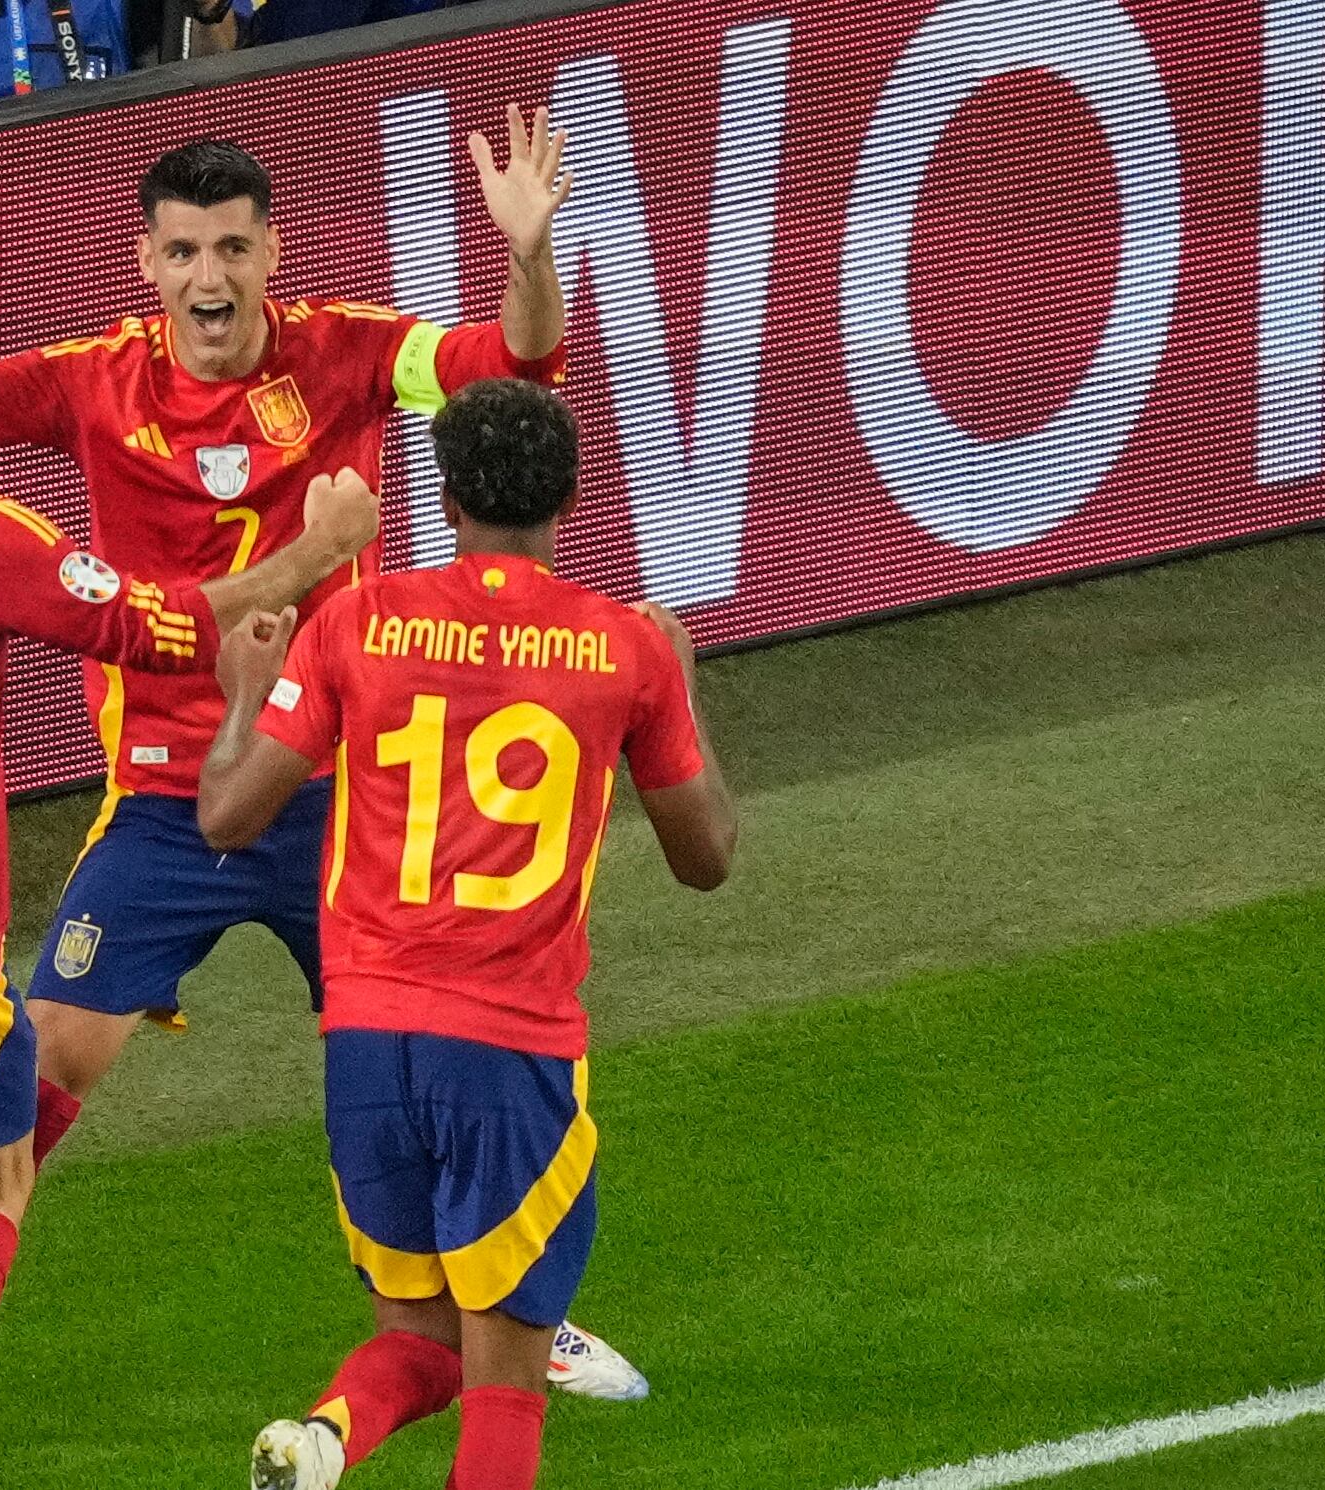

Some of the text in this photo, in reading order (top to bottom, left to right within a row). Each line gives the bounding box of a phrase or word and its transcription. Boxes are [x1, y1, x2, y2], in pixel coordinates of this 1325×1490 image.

[58, 21, 83, 82] SONY
[215, 507, 261, 576] 7
[363, 614, 617, 674] LAMINE YAMAL
[376, 694, 581, 911] 19
